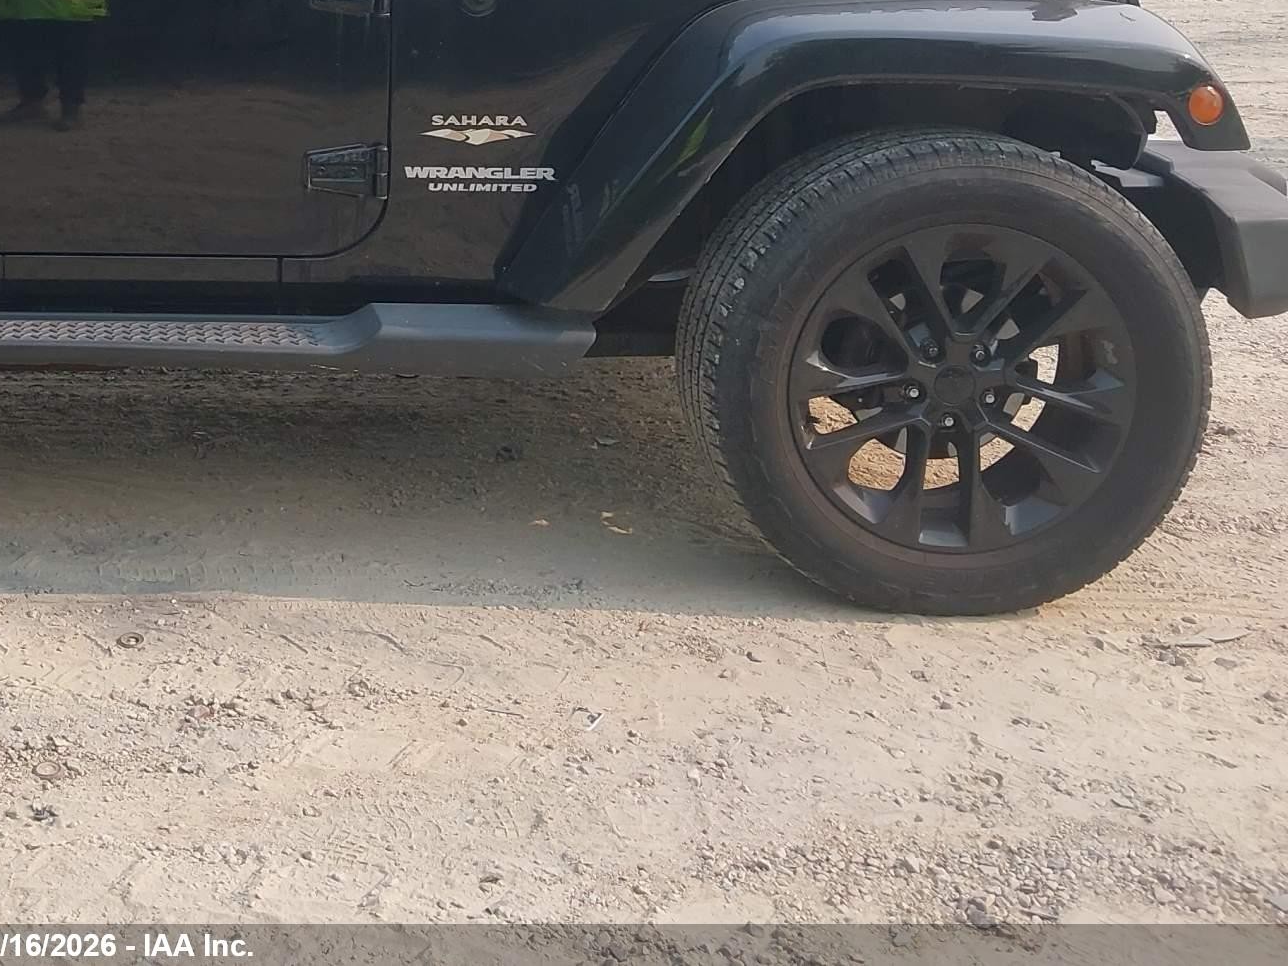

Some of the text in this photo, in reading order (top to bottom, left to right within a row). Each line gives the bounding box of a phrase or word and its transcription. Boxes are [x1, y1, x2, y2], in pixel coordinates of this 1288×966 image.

[431, 114, 528, 126] SAHARA
[404, 166, 556, 181] WRANGLER
[428, 183, 538, 192] UNLIMITED
